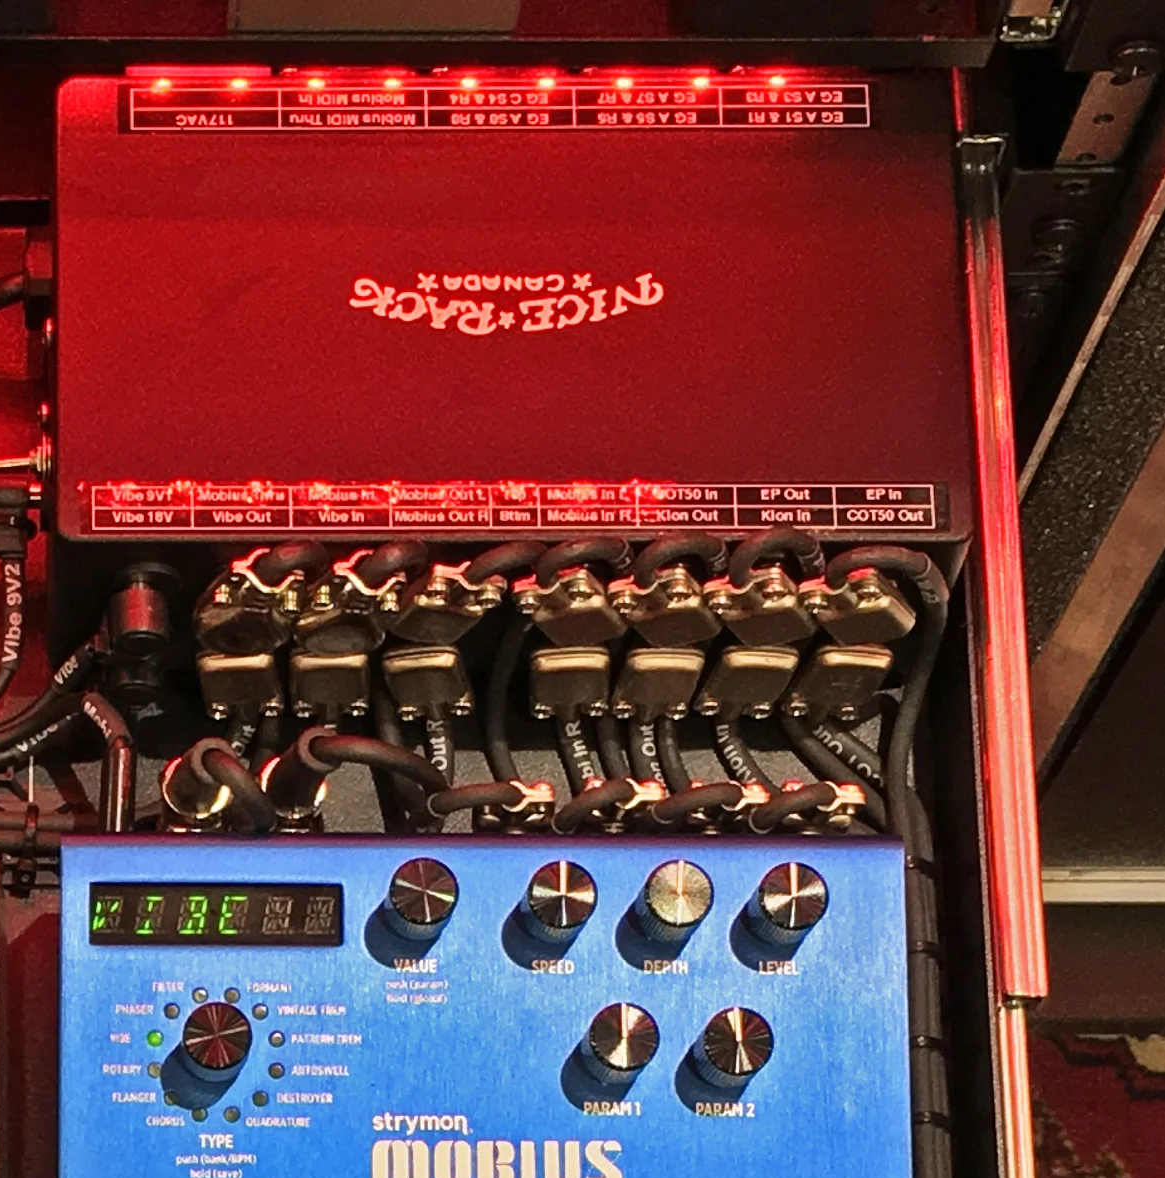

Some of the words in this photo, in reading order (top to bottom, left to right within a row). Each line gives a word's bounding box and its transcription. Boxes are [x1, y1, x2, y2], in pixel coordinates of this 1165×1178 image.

[176, 113, 234, 126] 117VAC
[289, 112, 322, 126] Thru
[324, 112, 359, 126] MIDI
[361, 112, 416, 126] Mobius
[442, 275, 565, 292] CANADA
[349, 278, 498, 336] RACK
[518, 272, 664, 332] NICE
[760, 489, 781, 501] EP
[783, 489, 810, 501] Out
[866, 489, 886, 501] EP
[888, 489, 903, 501] In
[112, 510, 144, 523] Vibe
[212, 510, 243, 523] Vibe
[245, 510, 272, 523] Out
[317, 511, 350, 523] Vibe
[351, 511, 365, 523] In
[394, 511, 445, 523] Mobius
[448, 511, 474, 523] Out
[477, 511, 489, 523] R
[547, 510, 598, 523] Mobius
[601, 510, 615, 523] In
[618, 510, 632, 523] R
[656, 510, 689, 523] Klon
[691, 510, 719, 523] Out
[760, 510, 795, 522] Klon
[797, 510, 812, 522] In
[846, 509, 896, 522] COT50
[898, 509, 924, 522] Out
[4, 563, 23, 606] 9V2
[1, 610, 23, 663] Vibe
[393, 958, 438, 974] VALUE
[531, 960, 575, 975] SPEED
[643, 960, 688, 975] DEPTH
[758, 960, 799, 975] LEVEL
[115, 1004, 154, 1015] PHASER
[102, 1065, 141, 1075] ROTARY
[291, 1065, 350, 1077] AUTOSWELL
[112, 1093, 156, 1104] FLANGER
[277, 1093, 333, 1104] DESTROYER
[583, 1102, 633, 1117] PARAM
[634, 1101, 641, 1116] 1
[696, 1103, 744, 1118] PARAM
[745, 1103, 756, 1117] 2
[146, 1116, 186, 1127] CHORUS
[245, 1116, 311, 1128] QUADRATURE
[372, 1111, 468, 1136] strymon
[198, 1134, 234, 1149] TYPE
[175, 1154, 198, 1166] push
[189, 1168, 211, 1178] hold
